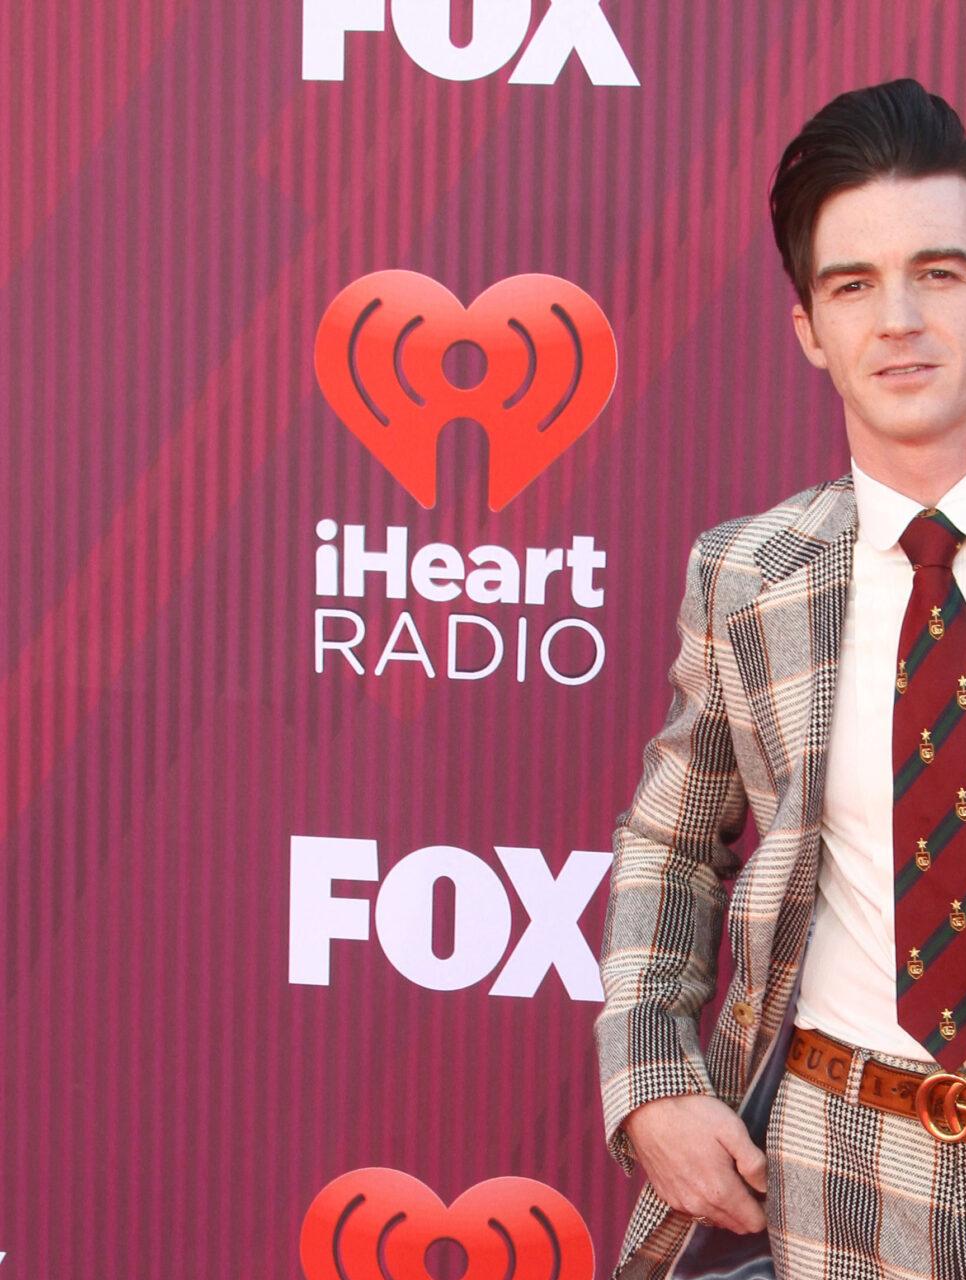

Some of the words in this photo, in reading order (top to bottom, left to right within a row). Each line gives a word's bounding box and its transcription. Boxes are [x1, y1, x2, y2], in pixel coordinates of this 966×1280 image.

[315, 518, 606, 609] iHeart
[314, 608, 606, 686] RADIO
[288, 834, 614, 1003] FOX
